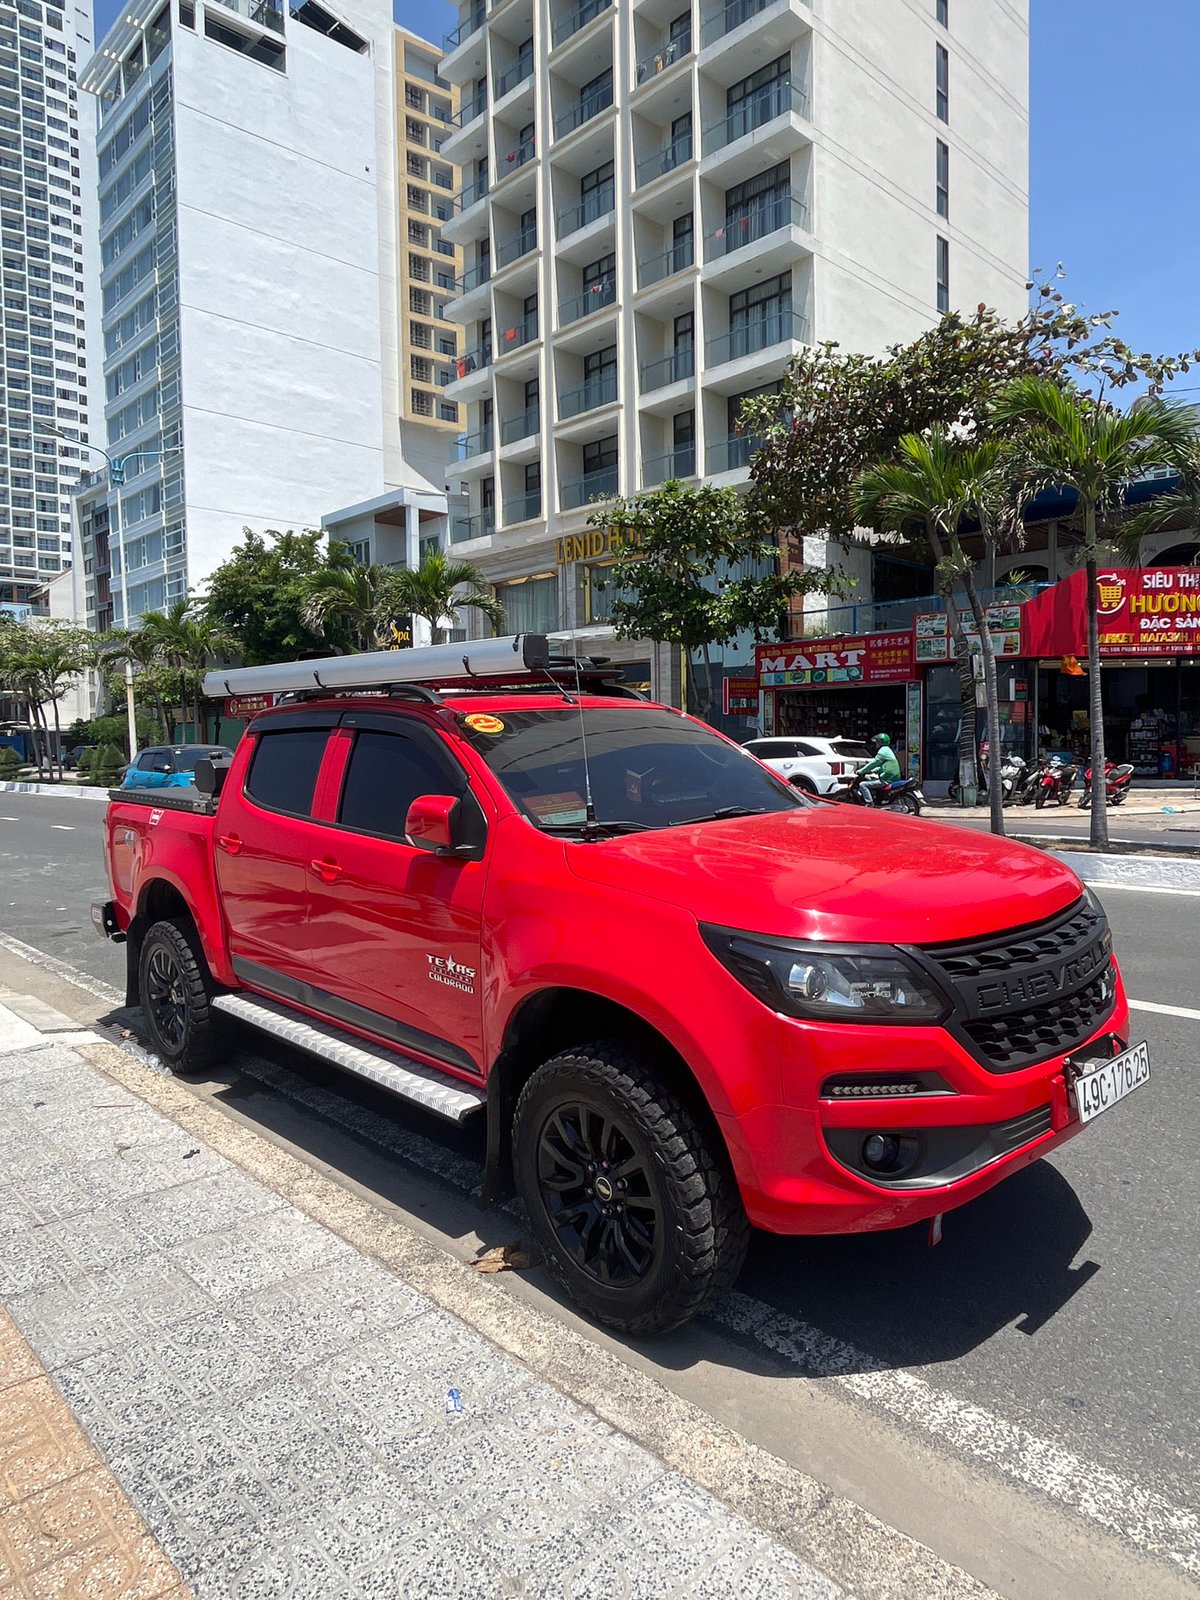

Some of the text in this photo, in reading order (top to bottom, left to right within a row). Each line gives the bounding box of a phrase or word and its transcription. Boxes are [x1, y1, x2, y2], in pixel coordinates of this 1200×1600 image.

[556, 530, 605, 564] LENID
[1143, 571, 1173, 588] SIÊU
[1140, 615, 1171, 631] ĐẶC
[1098, 633, 1134, 644] ARKET
[760, 650, 867, 672] MART
[426, 954, 477, 978] TEXAS
[428, 971, 475, 994] COLORADO
